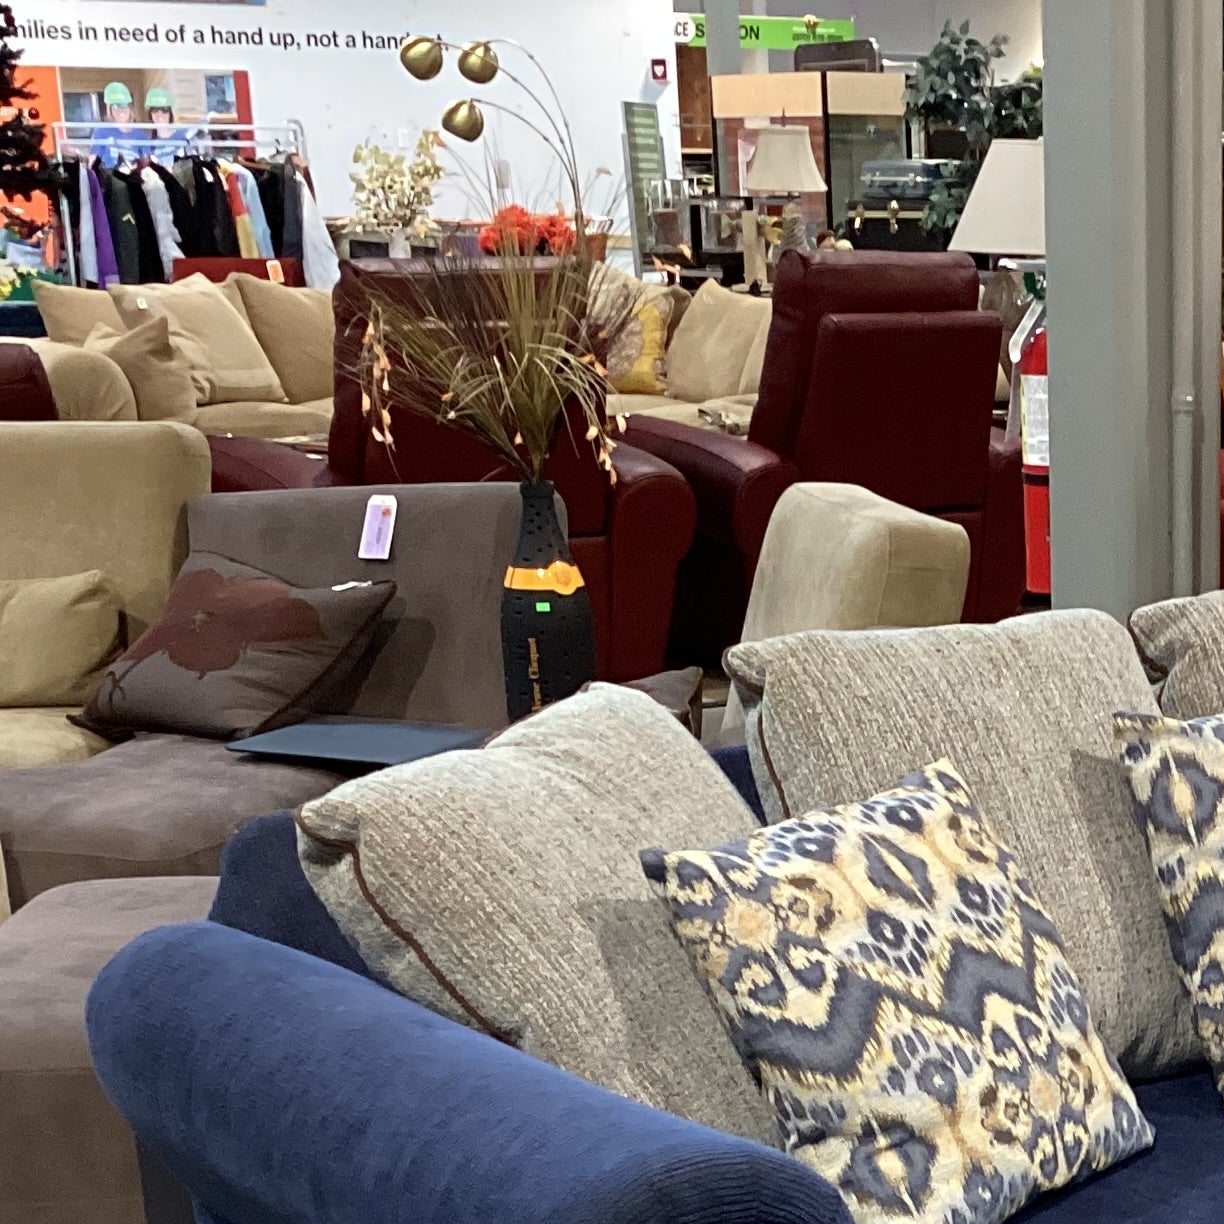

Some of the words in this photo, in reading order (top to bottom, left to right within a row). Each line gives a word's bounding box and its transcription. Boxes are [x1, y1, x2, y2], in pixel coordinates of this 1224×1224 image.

[78, 21, 98, 40] in
[104, 23, 159, 42] need
[165, 24, 186, 43] of
[193, 29, 205, 44] a
[211, 25, 263, 45] hand
[269, 31, 301, 50] up,
[306, 30, 340, 48] not
[345, 34, 356, 48] a
